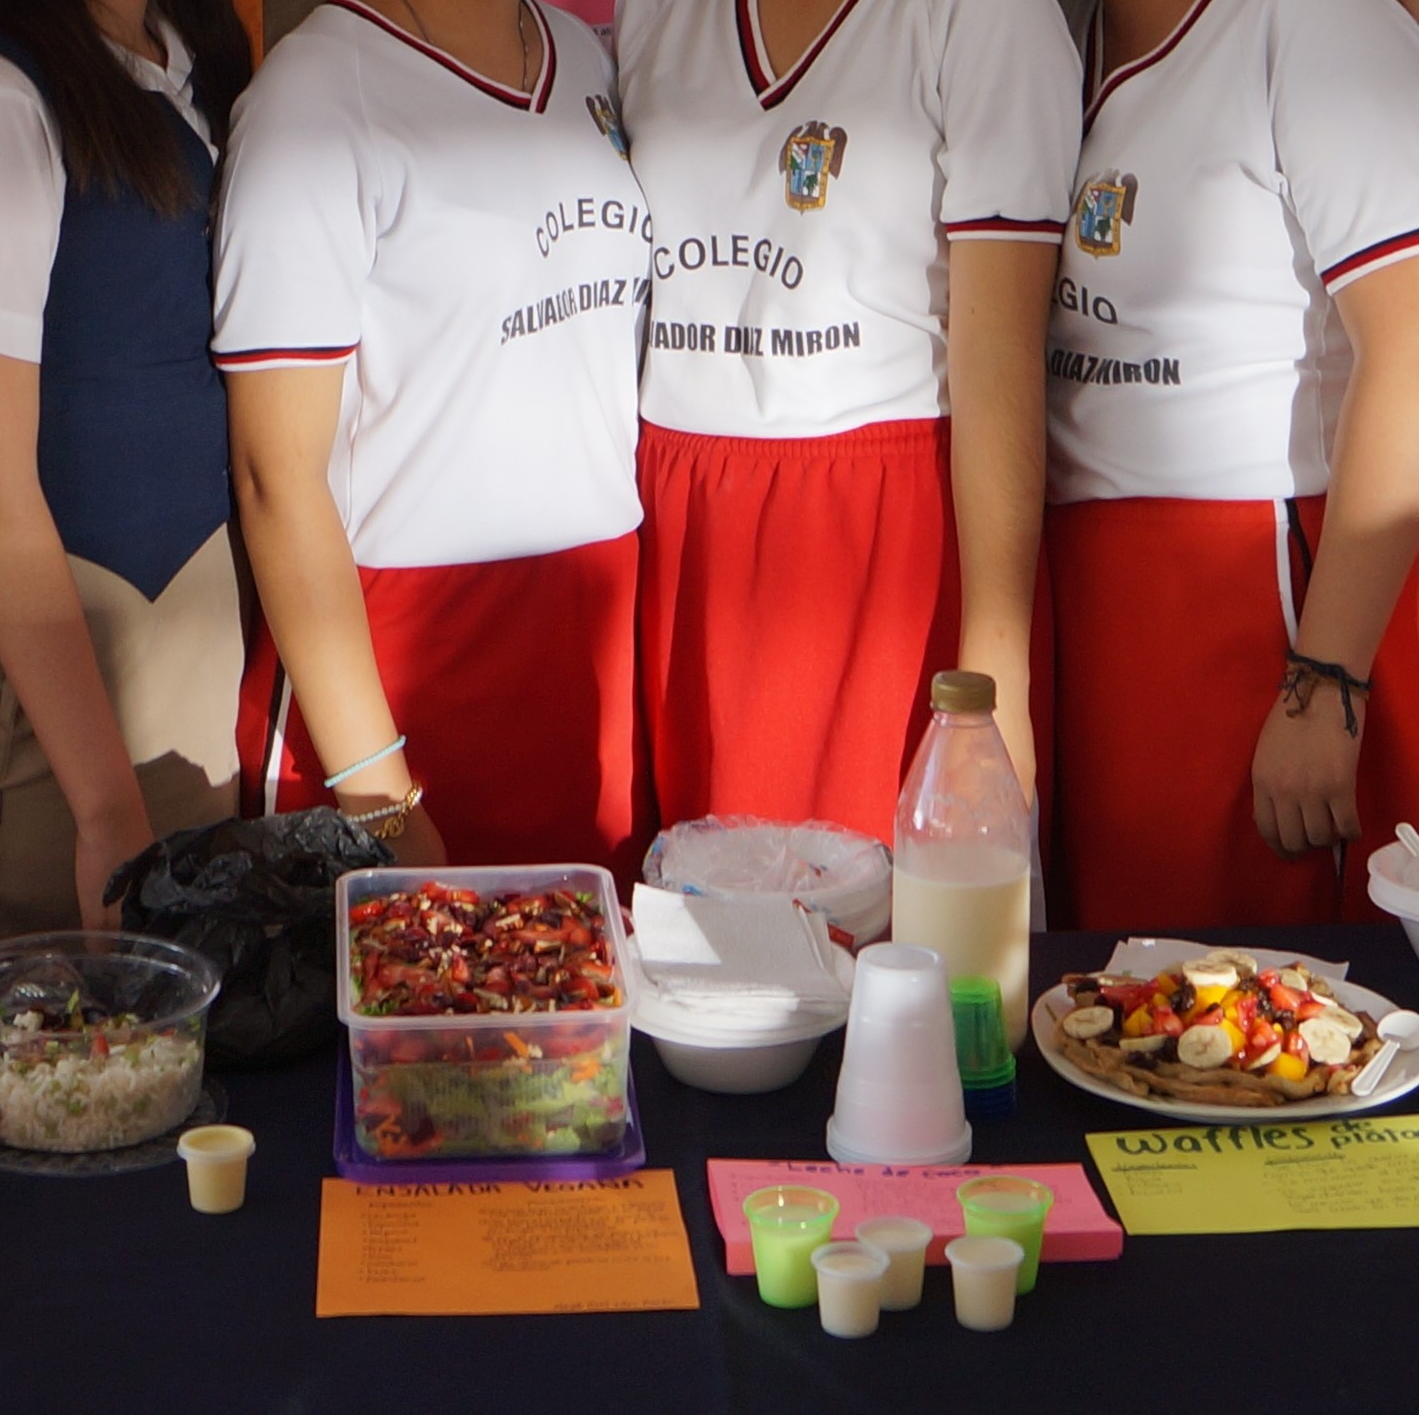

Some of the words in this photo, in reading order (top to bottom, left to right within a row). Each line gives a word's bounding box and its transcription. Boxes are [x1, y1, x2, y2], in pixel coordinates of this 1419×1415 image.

[653, 234, 805, 290] COLEGIO
[578, 278, 627, 312] DIAZ
[770, 321, 861, 358] MIRON
